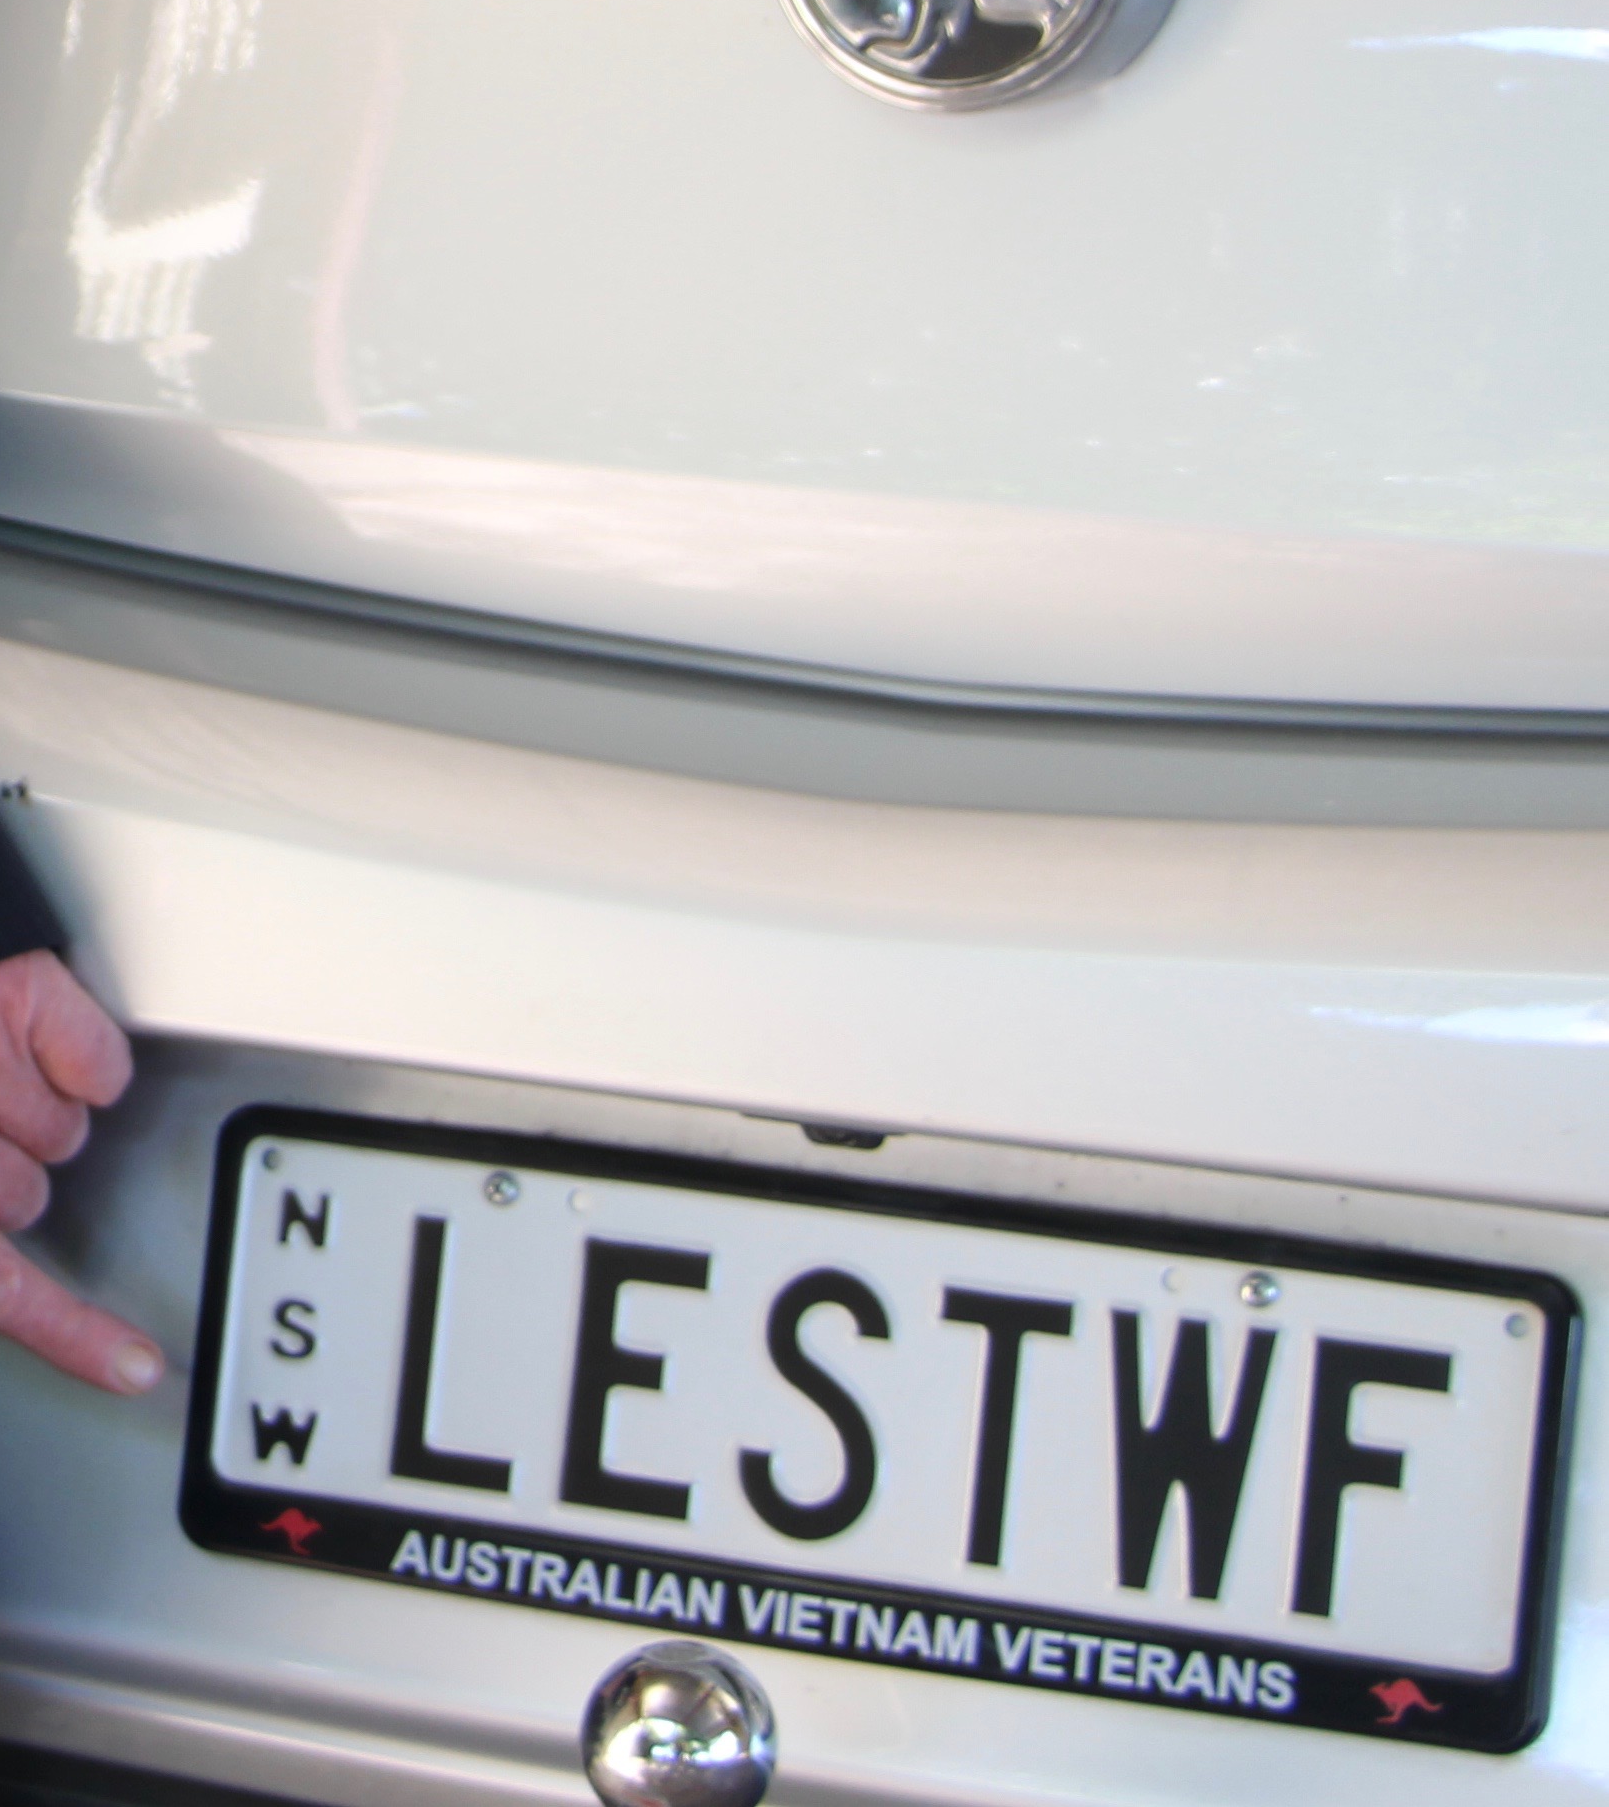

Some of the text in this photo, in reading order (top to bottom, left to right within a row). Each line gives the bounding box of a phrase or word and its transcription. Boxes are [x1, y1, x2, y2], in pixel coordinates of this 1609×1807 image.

[389, 1215, 1453, 1619] LESTWF
[389, 1529, 1295, 1710] AUSTRALIAN VIETNAM VETERANS
